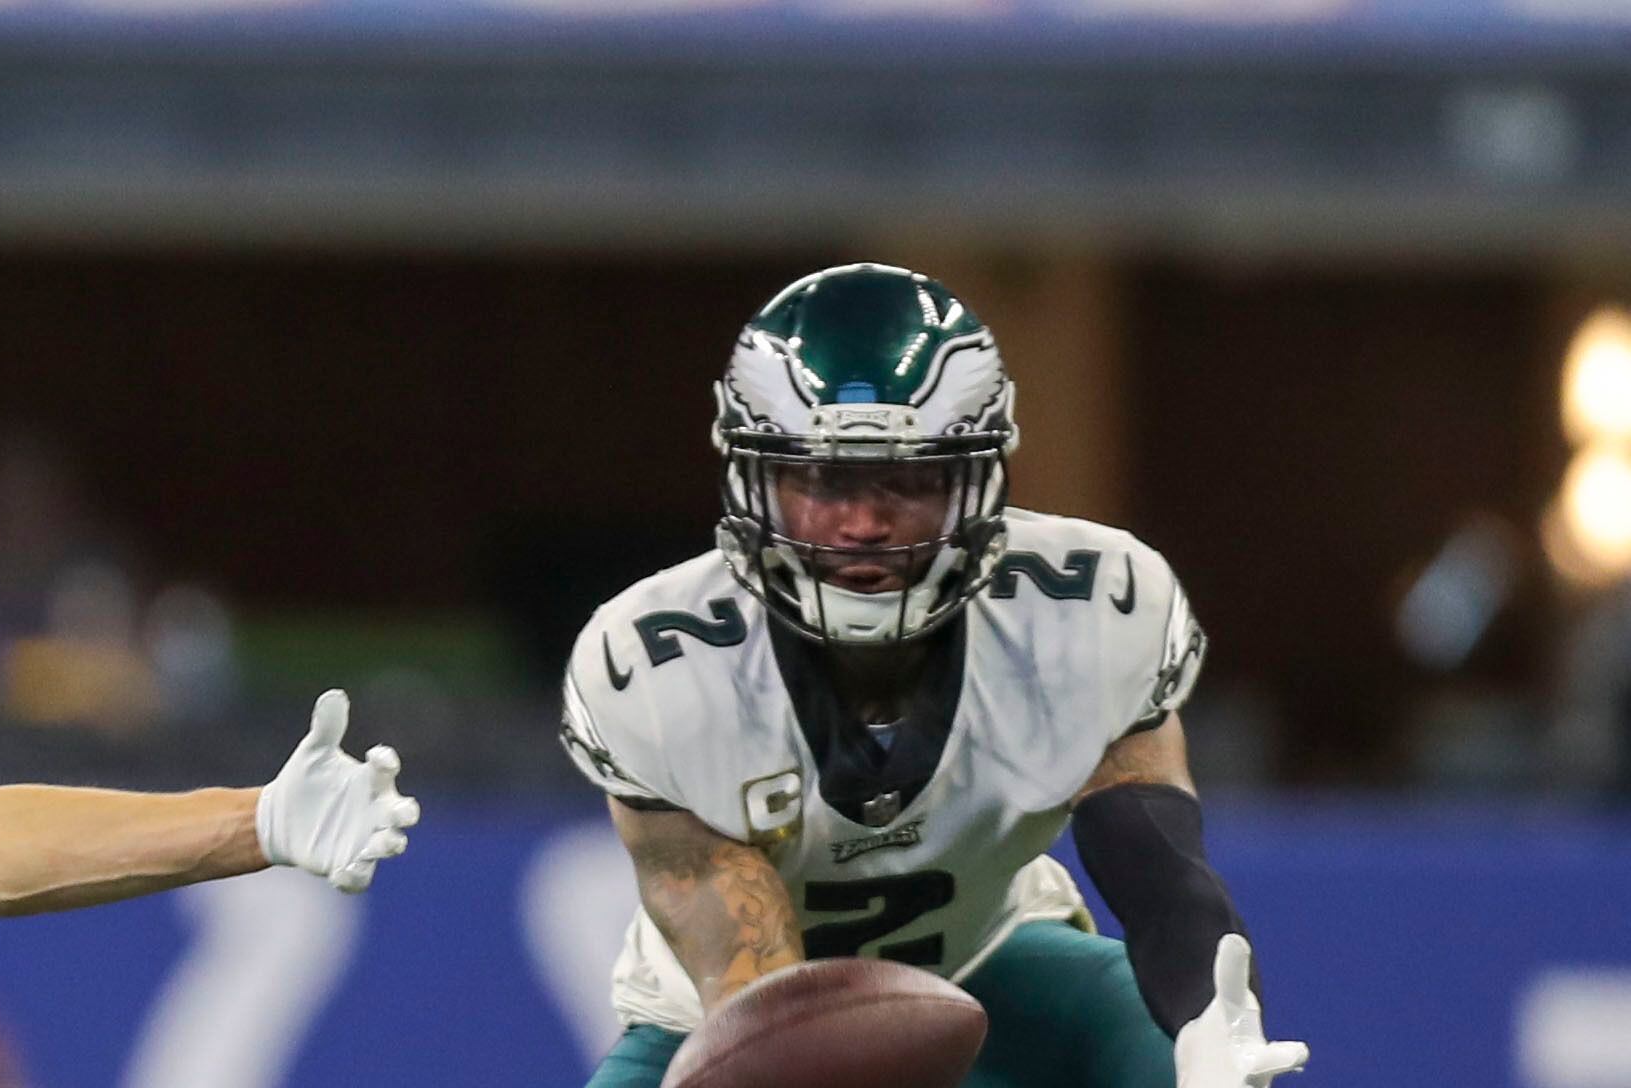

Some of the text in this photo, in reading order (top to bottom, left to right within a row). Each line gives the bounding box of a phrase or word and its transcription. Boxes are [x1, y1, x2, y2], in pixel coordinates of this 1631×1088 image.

[990, 549, 1101, 599] 2
[634, 597, 747, 667] 2
[745, 771, 802, 831] C
[801, 869, 956, 966] 2
